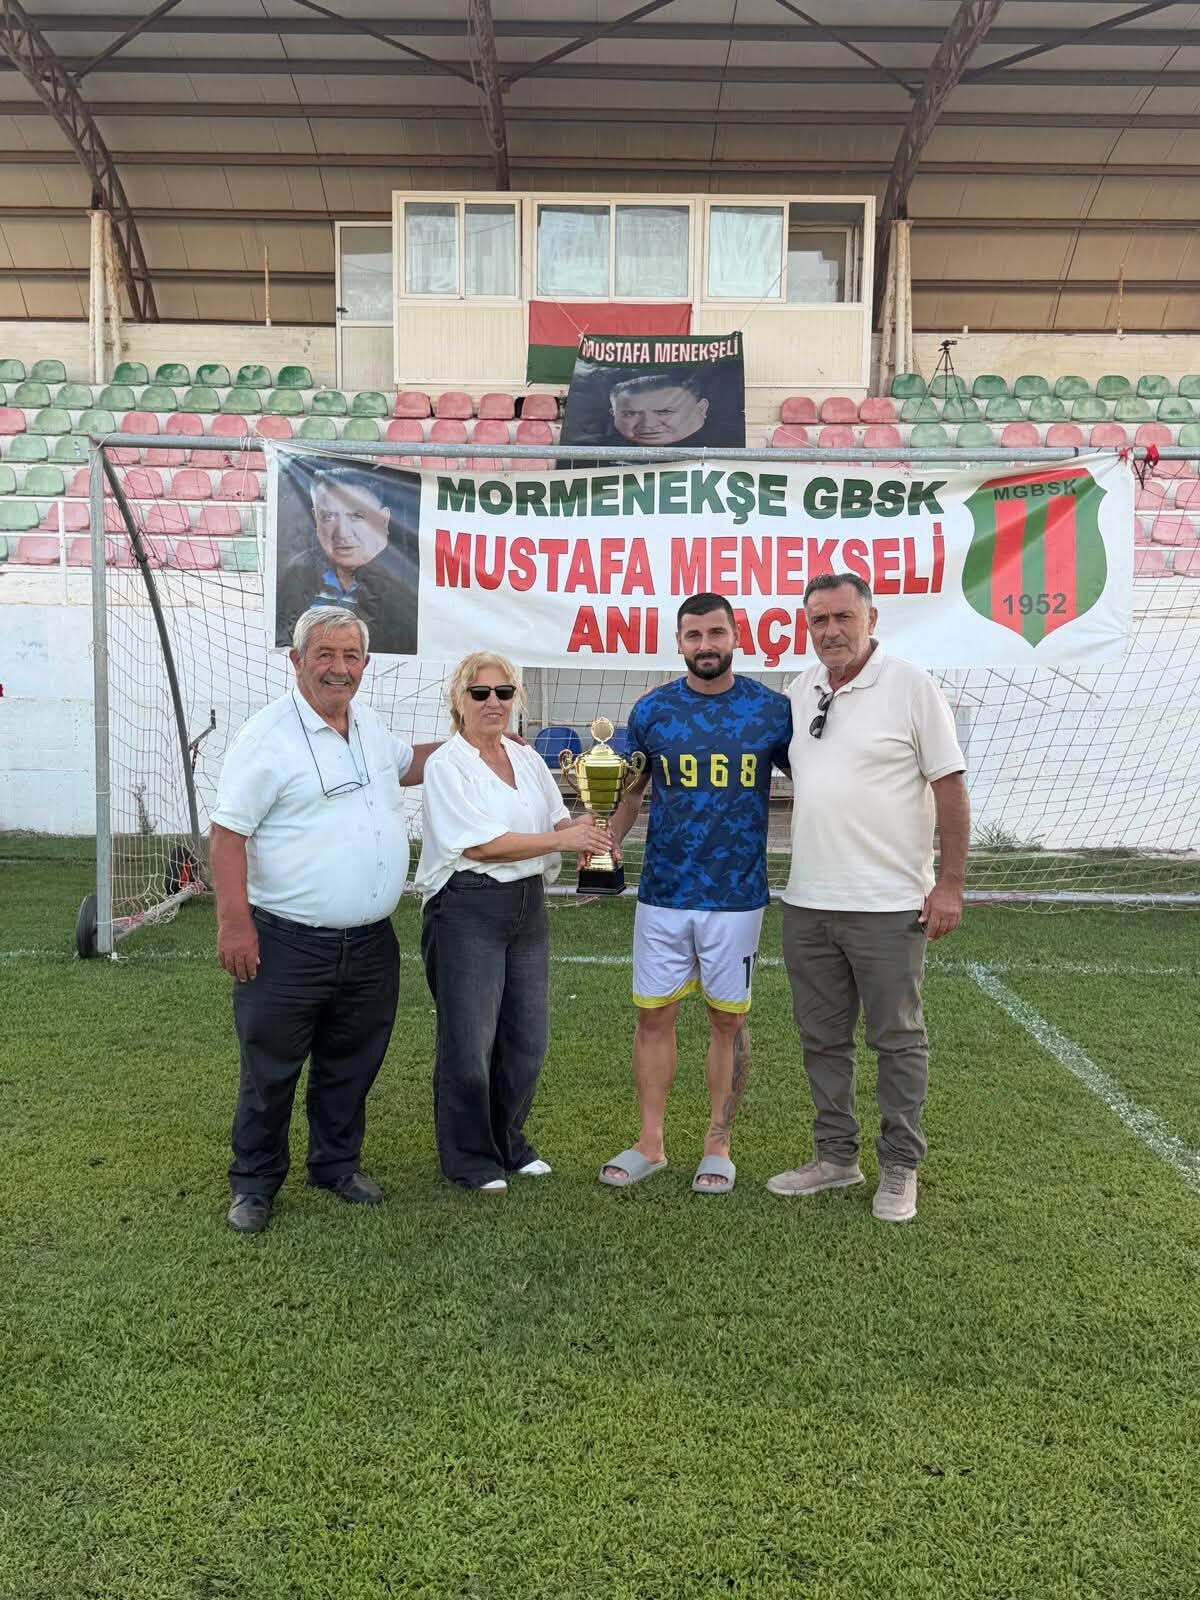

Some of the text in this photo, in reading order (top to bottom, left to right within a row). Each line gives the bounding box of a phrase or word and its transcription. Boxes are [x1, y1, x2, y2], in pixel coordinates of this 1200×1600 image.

[581, 337, 739, 363] MUSTAFA MENEKŞELİ
[436, 470, 948, 524] MORMENEKŞE GBSK
[993, 478, 1076, 500] MGBSK
[435, 529, 655, 596] MUSTAFA
[1002, 592, 1067, 616] 1952
[567, 605, 659, 655] ANI
[660, 753, 757, 787] 1968
